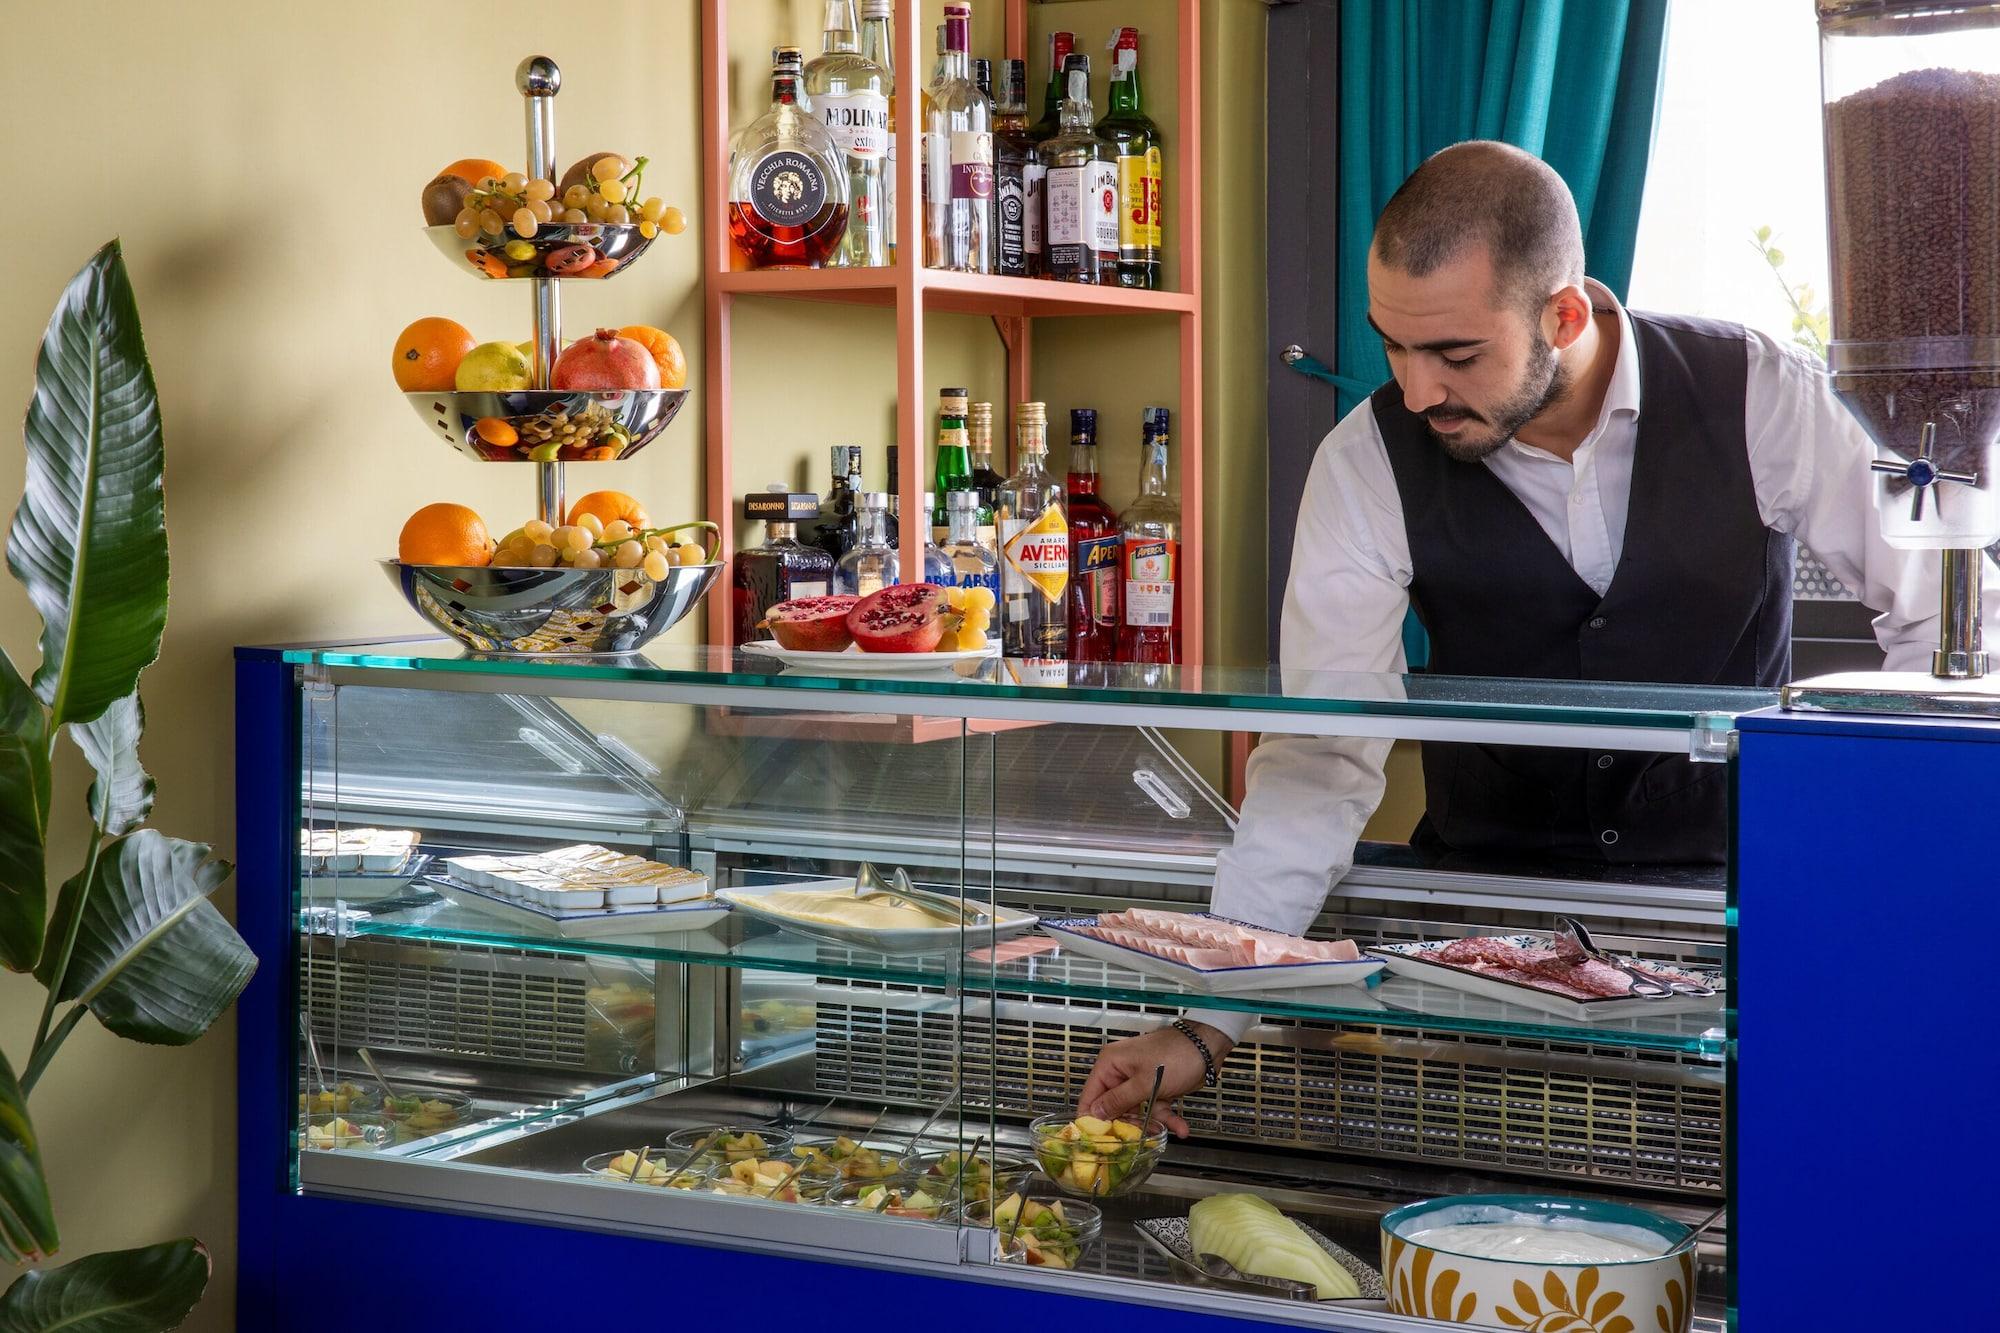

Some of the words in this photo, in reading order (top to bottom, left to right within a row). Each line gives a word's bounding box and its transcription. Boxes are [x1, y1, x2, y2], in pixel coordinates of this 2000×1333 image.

[757, 159, 784, 191] VECCHIA
[785, 157, 818, 192] ROMAGNA
[1091, 174, 1105, 194] JIM
[748, 502, 785, 511] DISARONNO
[1137, 546, 1164, 557] APEROL
